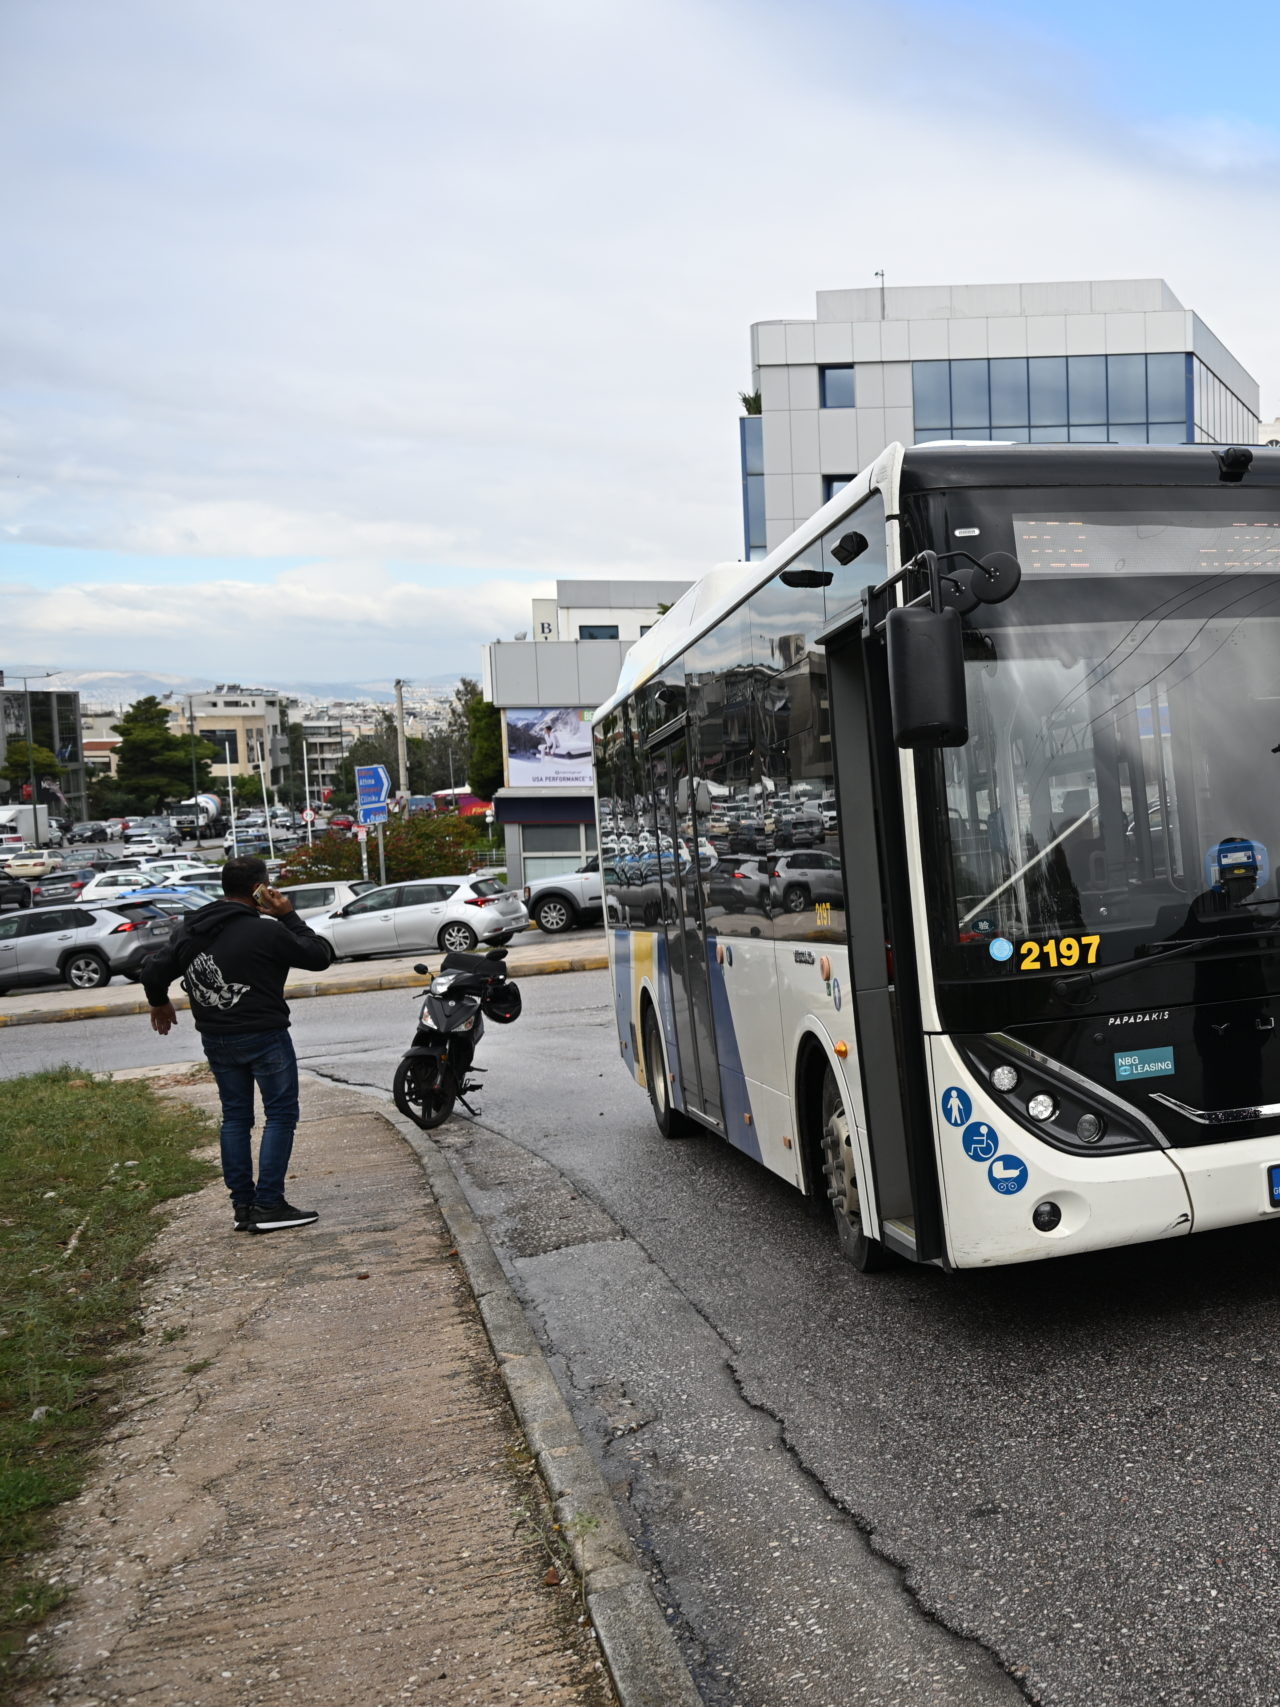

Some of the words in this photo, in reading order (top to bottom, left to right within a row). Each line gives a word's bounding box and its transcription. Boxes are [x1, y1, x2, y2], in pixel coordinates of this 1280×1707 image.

[816, 903, 831, 926] 2197
[1020, 935, 1100, 970] 2197
[1108, 1011, 1169, 1026] PAPADAKIS
[1118, 1056, 1139, 1066] NBG
[1133, 1061, 1172, 1073] LEASING
